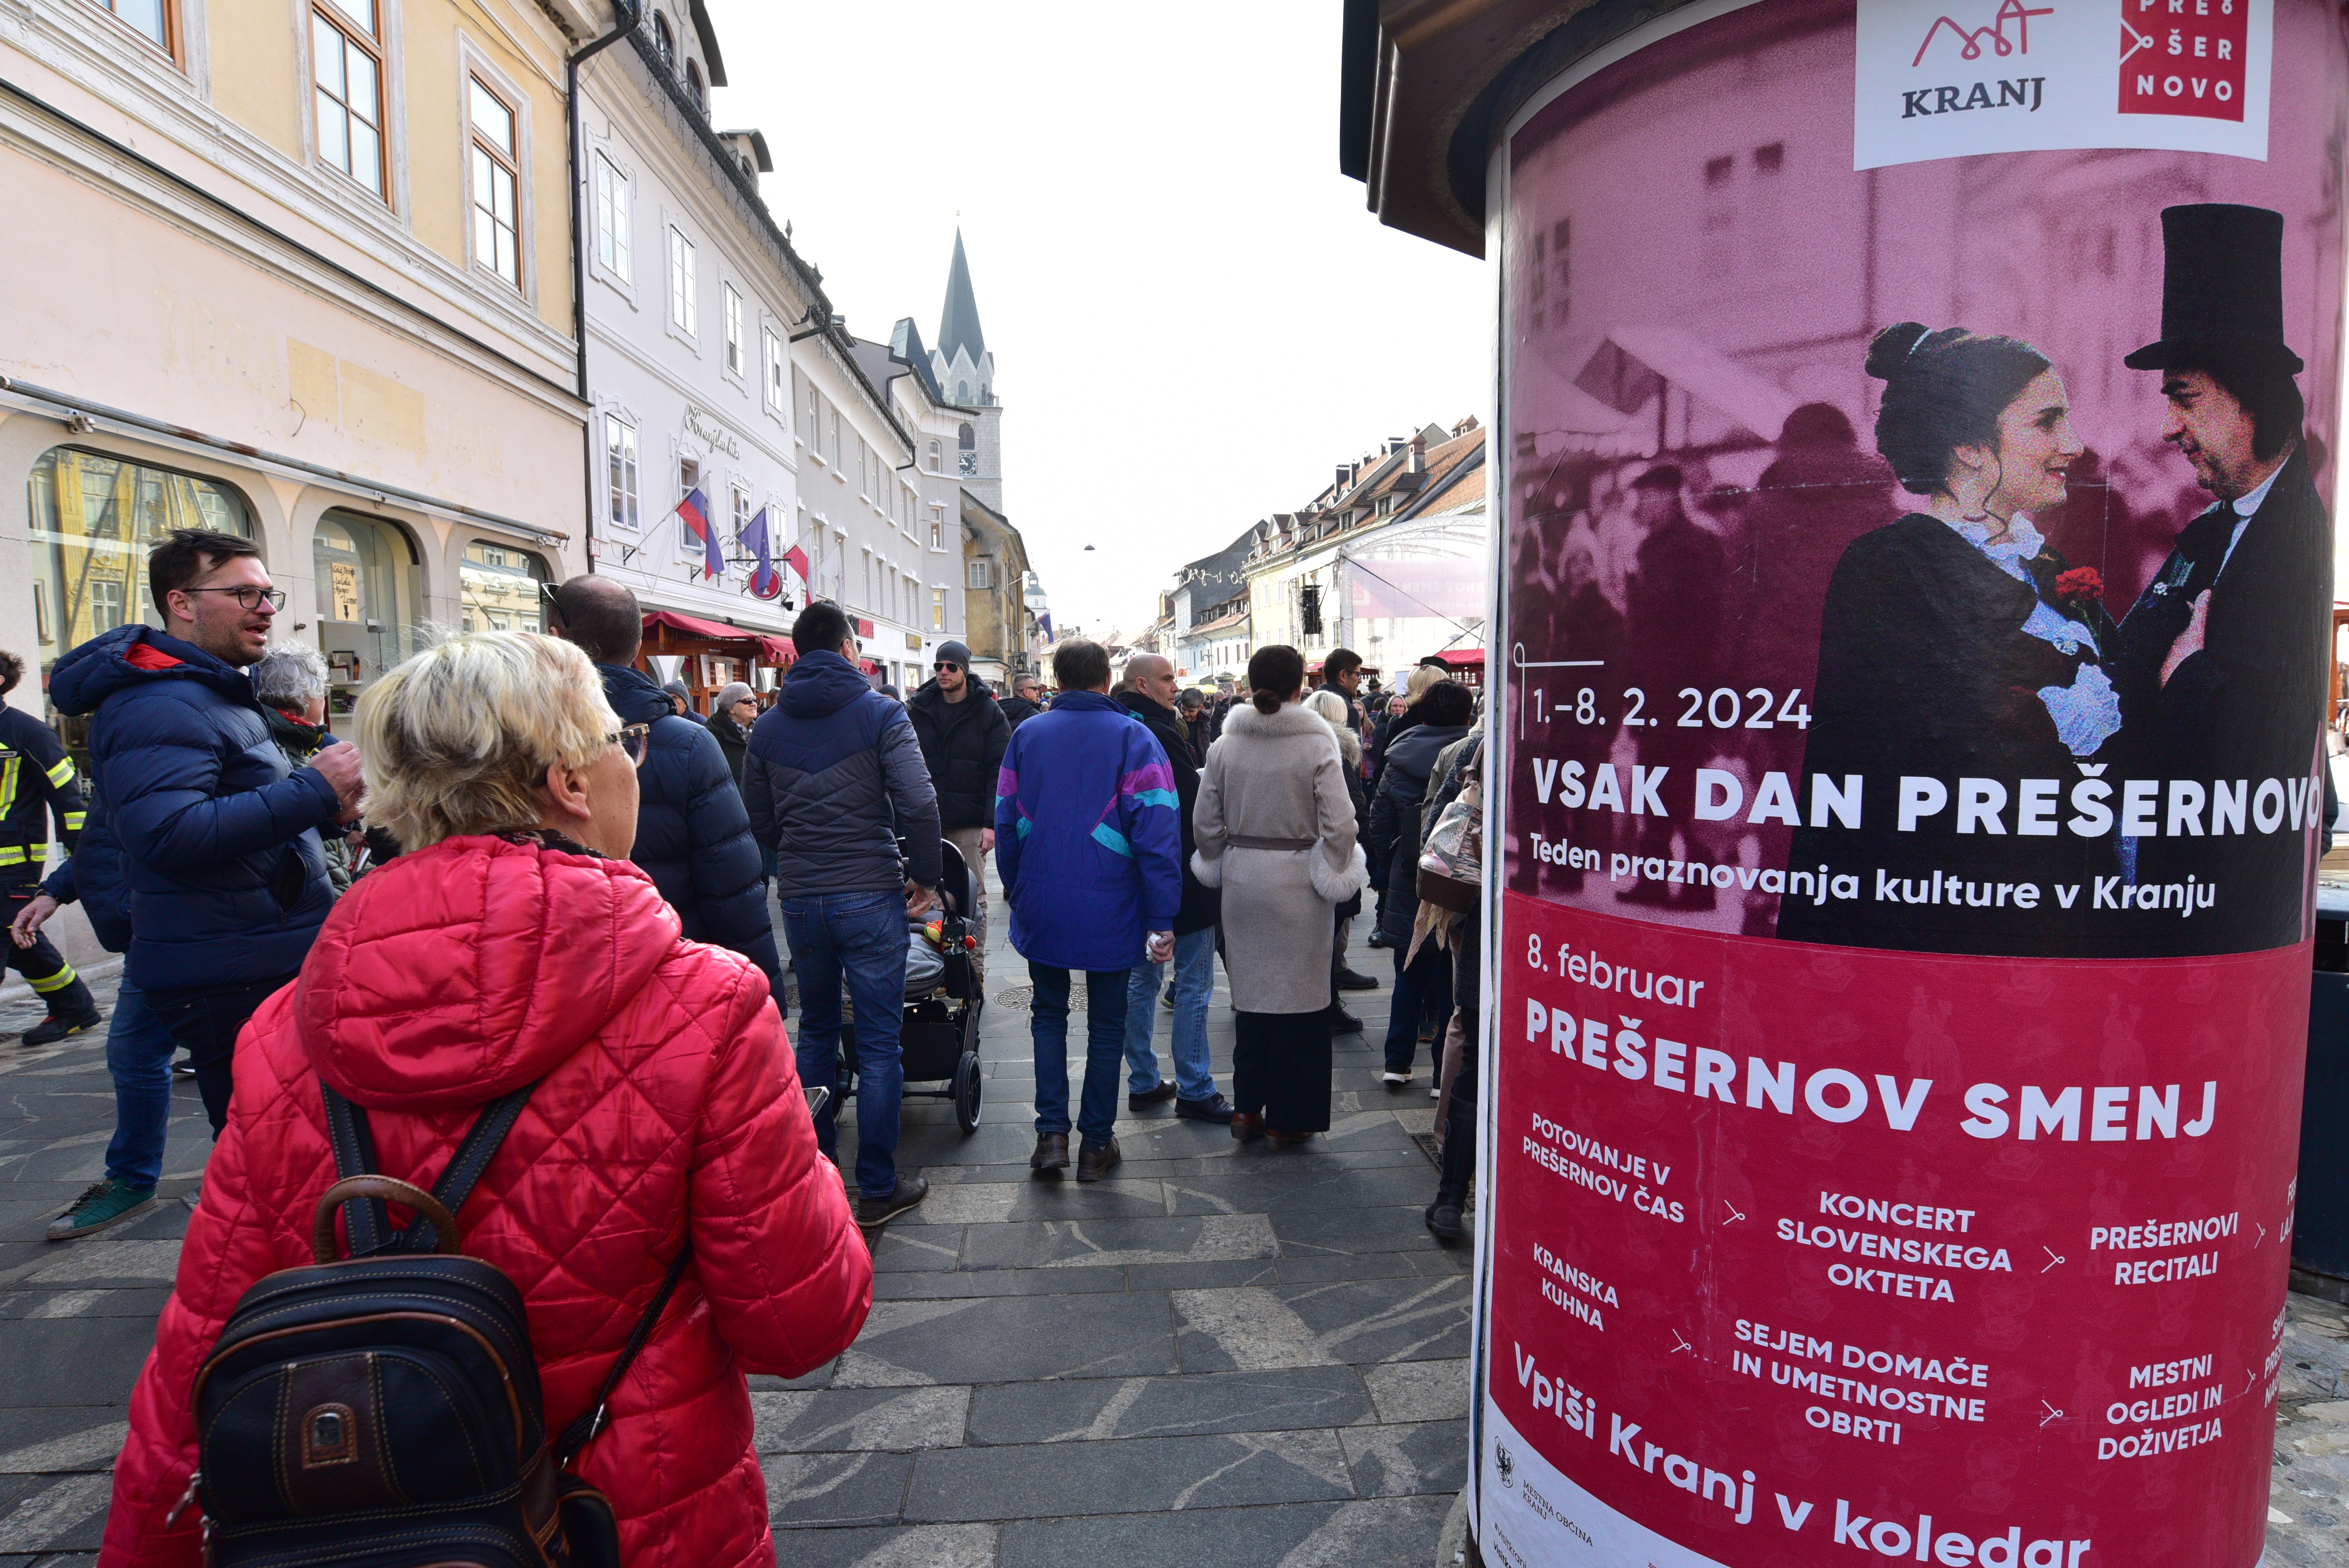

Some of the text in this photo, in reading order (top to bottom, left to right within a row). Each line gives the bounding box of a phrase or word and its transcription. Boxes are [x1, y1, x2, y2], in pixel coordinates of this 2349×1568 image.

[2167, 29, 2231, 60] ŠER
[1902, 77, 2046, 118] KRANJ
[2137, 75, 2232, 101] NOVO
[1623, 688, 1657, 727] 2.
[1677, 688, 1812, 729] 2024
[1533, 757, 2320, 837] VSAK DAN PREŠERNOVO
[1530, 832, 2215, 918] Teden praznovanja kulture v Kranju
[1527, 934, 1704, 1008] 8. februar
[1527, 997, 2216, 1141] PREŠERNOV SMENJ
[1533, 1112, 1670, 1185] POTOVANJE V
[1524, 1135, 1684, 1223] PREŠERNOV ČAS
[1820, 1191, 1975, 1233] KONCERT
[2091, 1212, 2239, 1250] PREŠERNOVI
[1776, 1218, 2012, 1272] SLOVENSKEGA
[2114, 1251, 2218, 1285] RECITALI
[1534, 1242, 1619, 1309] KRANSKA
[1828, 1264, 1955, 1303] OKTETA
[1542, 1277, 1604, 1332] KUHNA
[1734, 1319, 1988, 1387] SEJEM DOMAČE
[2129, 1354, 2212, 1389] MESTNI
[1733, 1350, 1985, 1422] IN UMETNOSTNE
[2106, 1384, 2223, 1425] OGLEDI IN
[1805, 1406, 1901, 1445] OBRTI
[2098, 1417, 2222, 1460] DOŽIVETJA
[1514, 1340, 2091, 1568] Vpiši Kranj v koledar
[1523, 1490, 1547, 1520] KRANJ
[1523, 1479, 1593, 1547] MESTNA OBČINA
